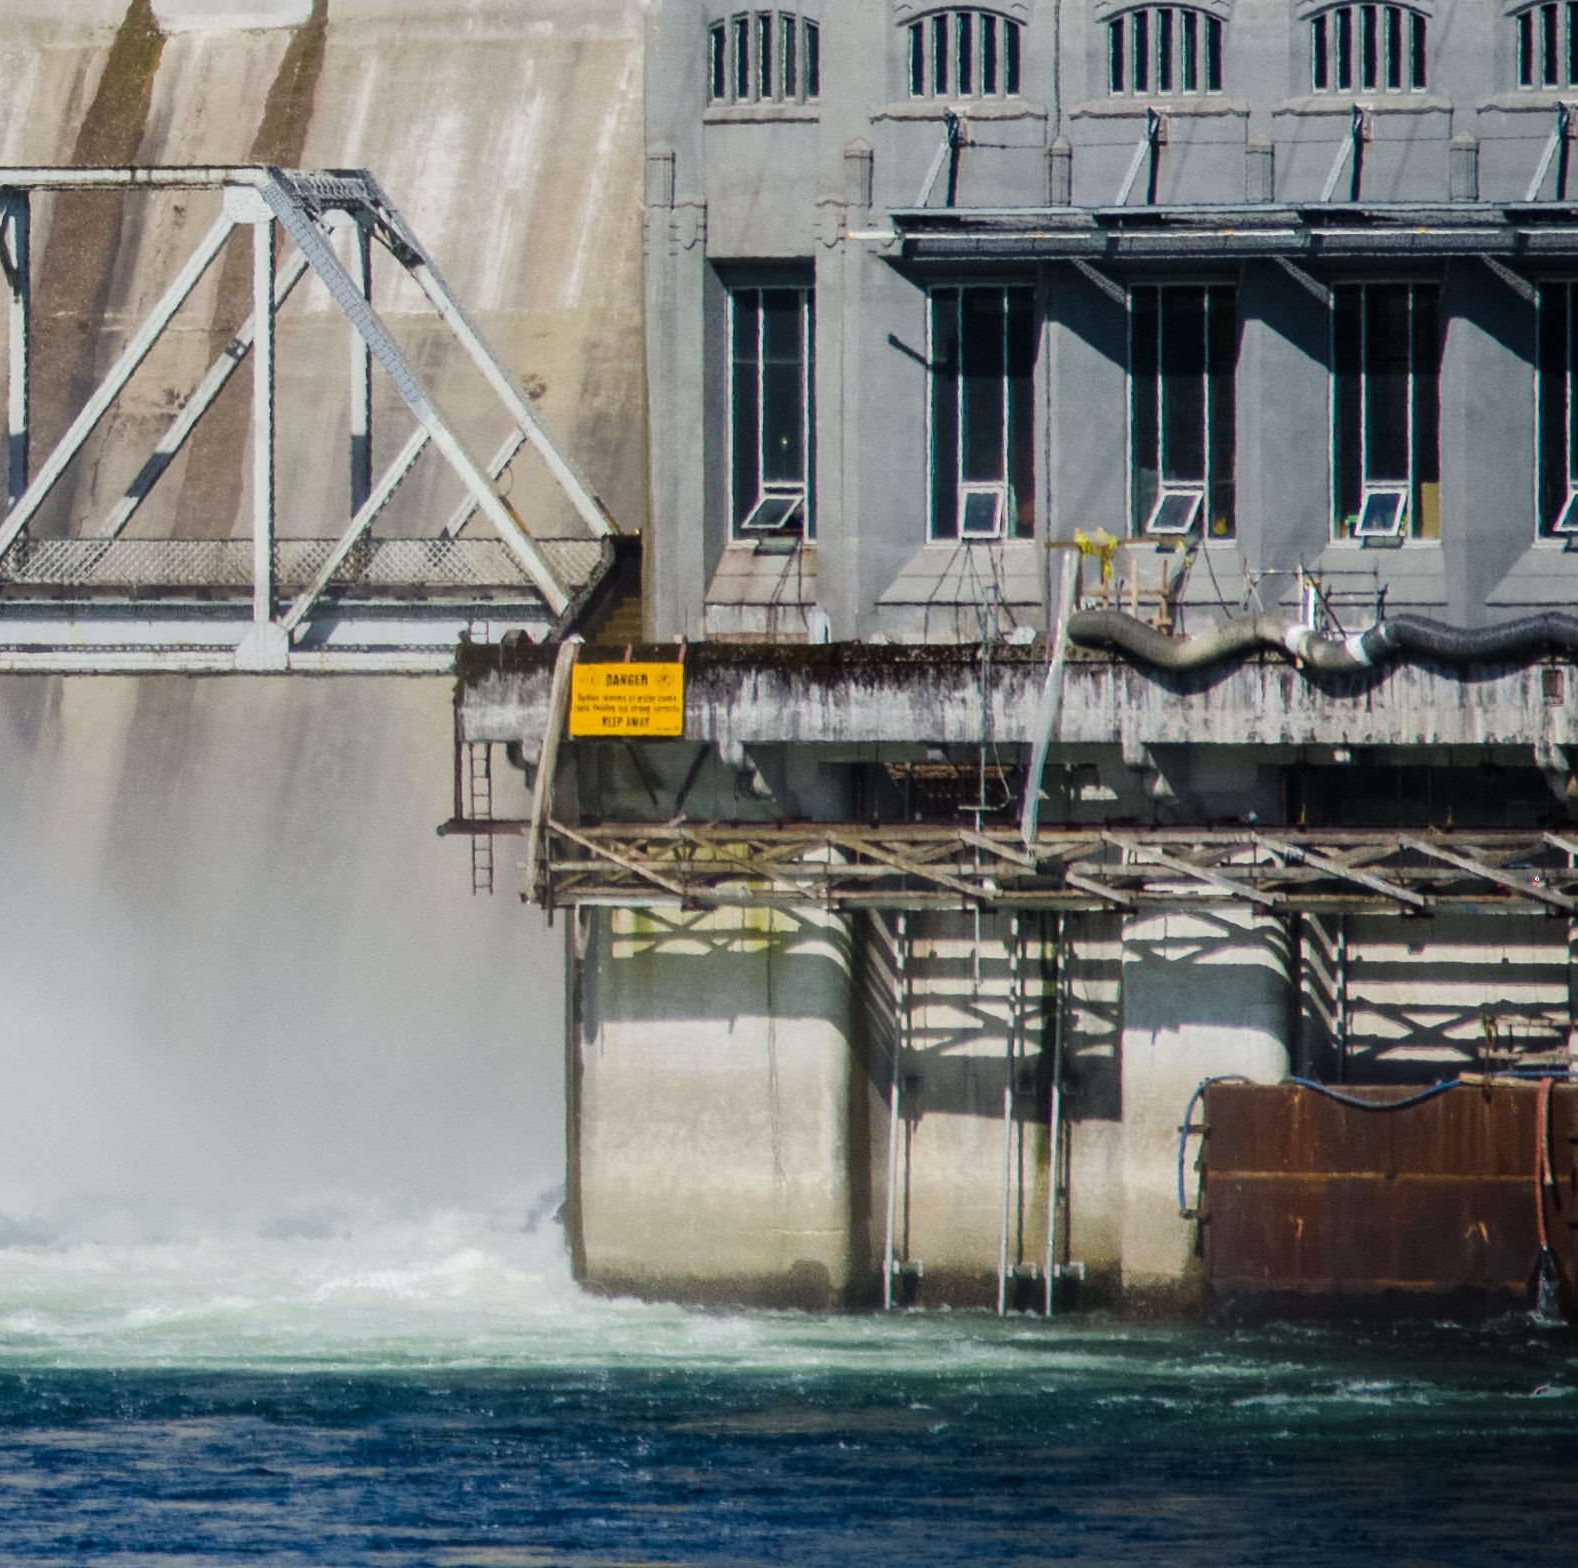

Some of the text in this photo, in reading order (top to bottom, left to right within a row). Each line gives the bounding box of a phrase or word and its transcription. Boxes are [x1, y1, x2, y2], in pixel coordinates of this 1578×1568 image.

[605, 673, 648, 686] DANGER
[602, 717, 650, 727] KEEP AWAY
